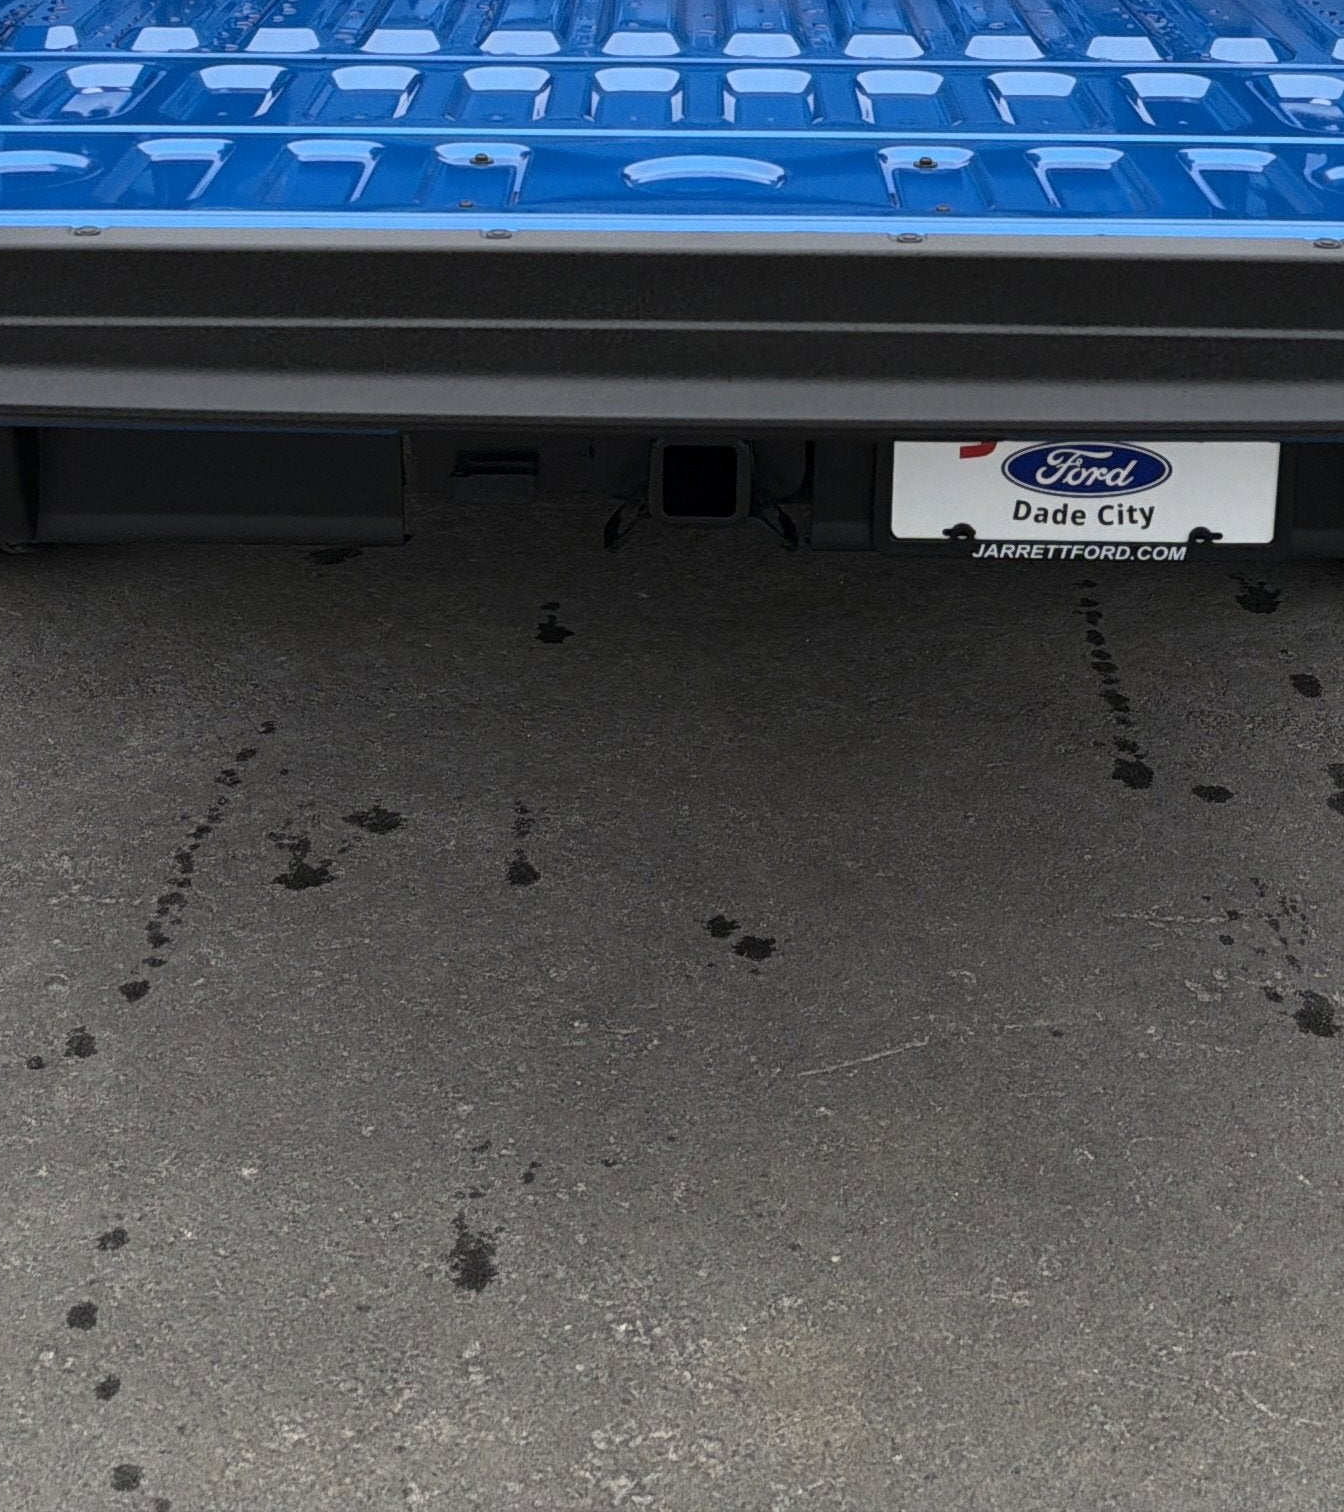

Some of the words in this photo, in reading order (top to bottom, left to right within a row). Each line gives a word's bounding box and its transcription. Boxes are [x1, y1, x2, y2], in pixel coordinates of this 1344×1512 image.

[1035, 448, 1138, 486] Ford
[1012, 499, 1087, 526] Dade
[1097, 503, 1155, 530] City
[973, 543, 1187, 561] JARRETTFORD.COM
